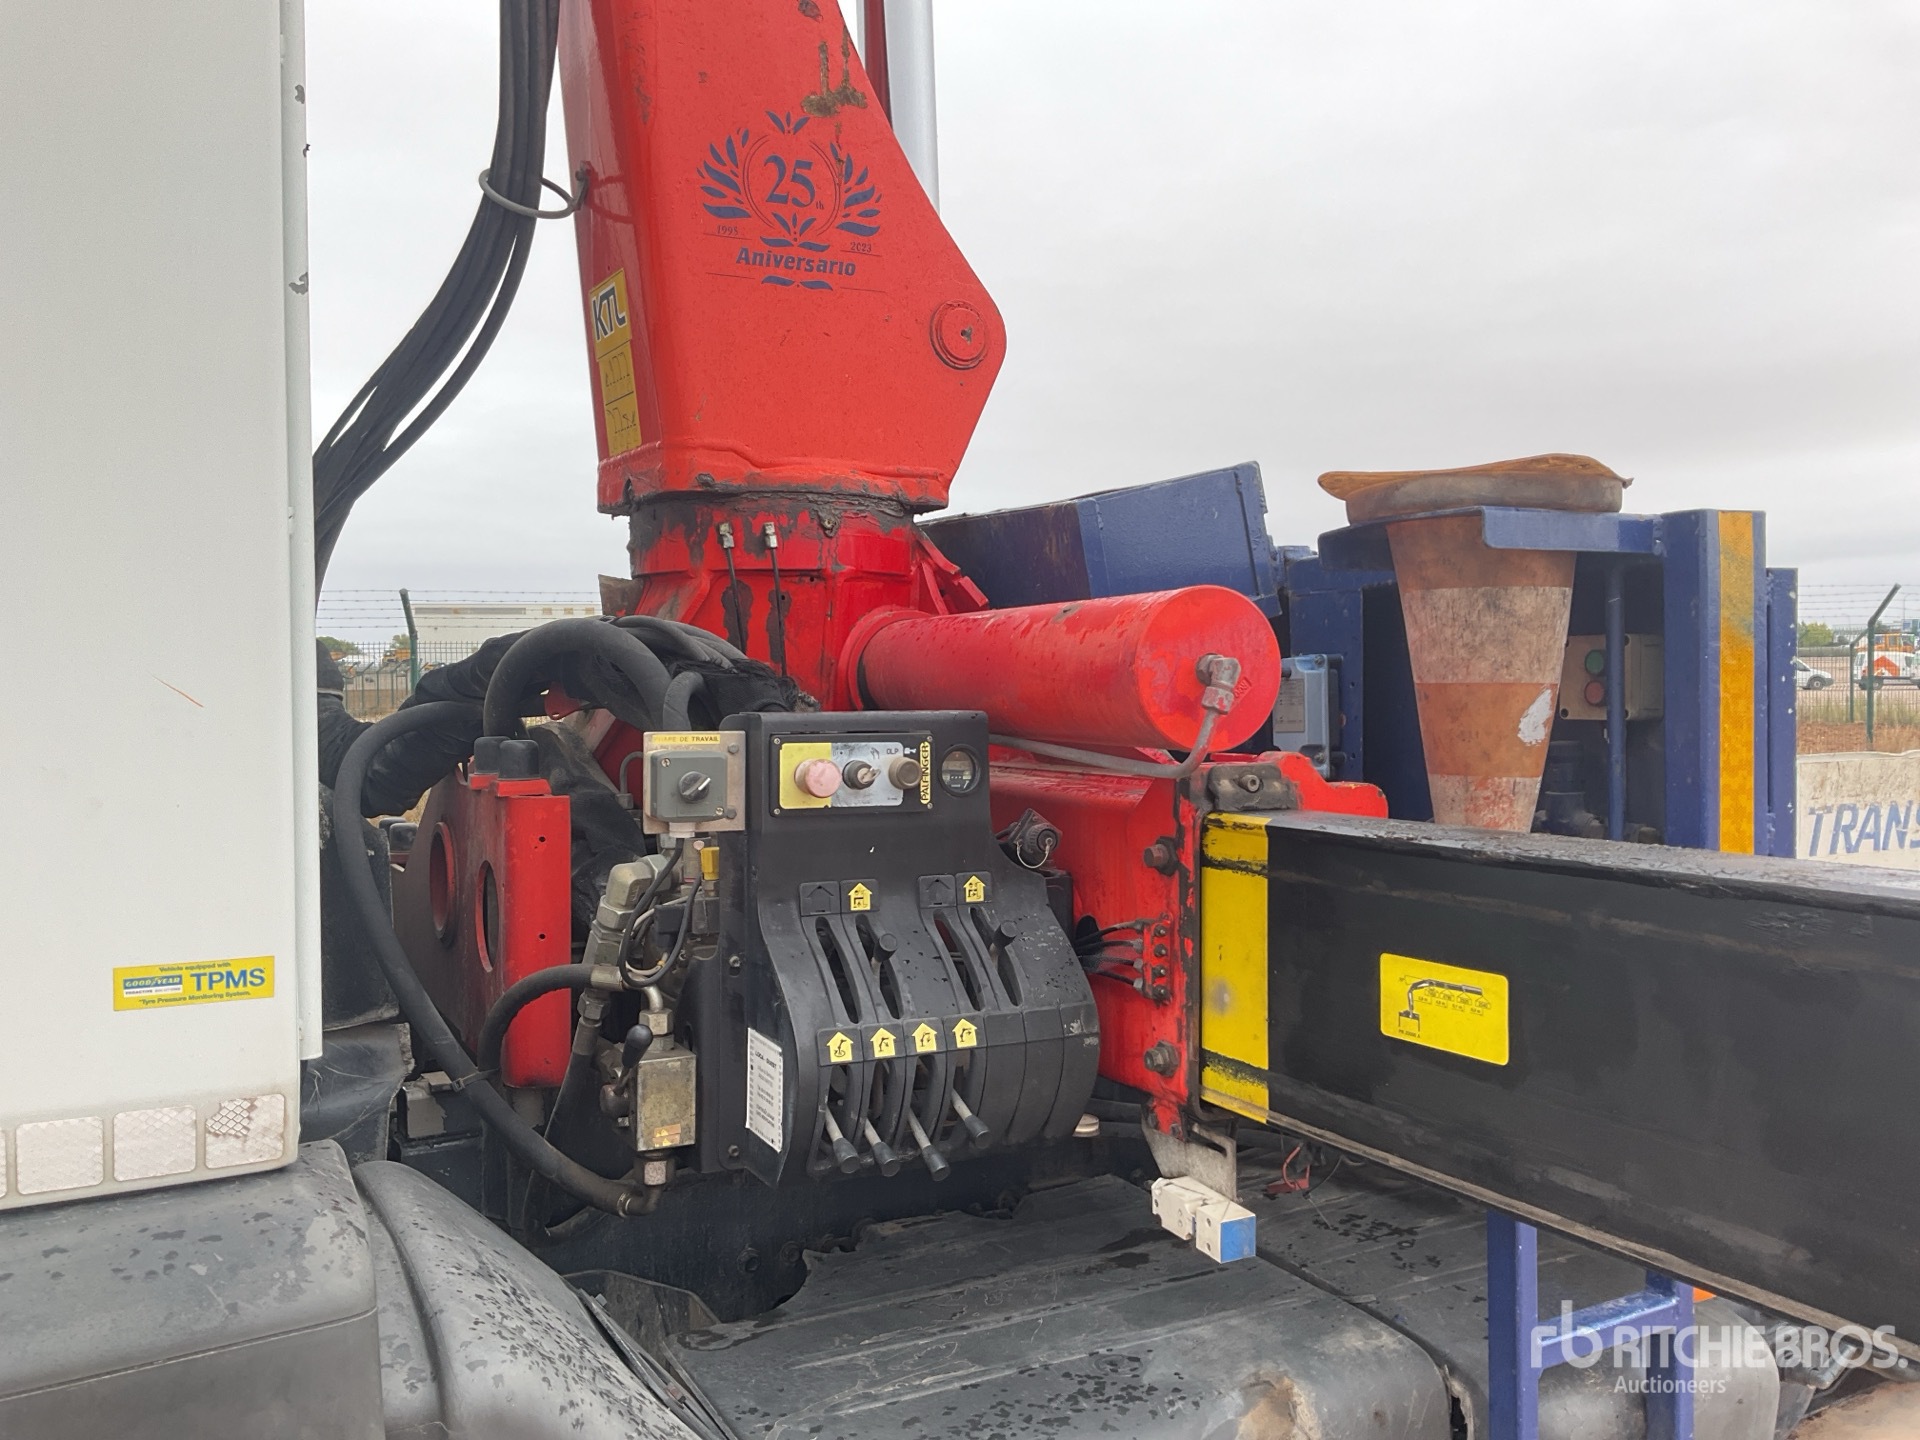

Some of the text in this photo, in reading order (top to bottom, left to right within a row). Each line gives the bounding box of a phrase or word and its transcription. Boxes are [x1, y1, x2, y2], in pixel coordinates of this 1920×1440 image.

[849, 240, 872, 253] 2023
[736, 247, 856, 276] Aniversario
[921, 742, 929, 801] PALFINGER
[184, 963, 216, 971] equipped
[125, 976, 181, 987] GOODYEAR
